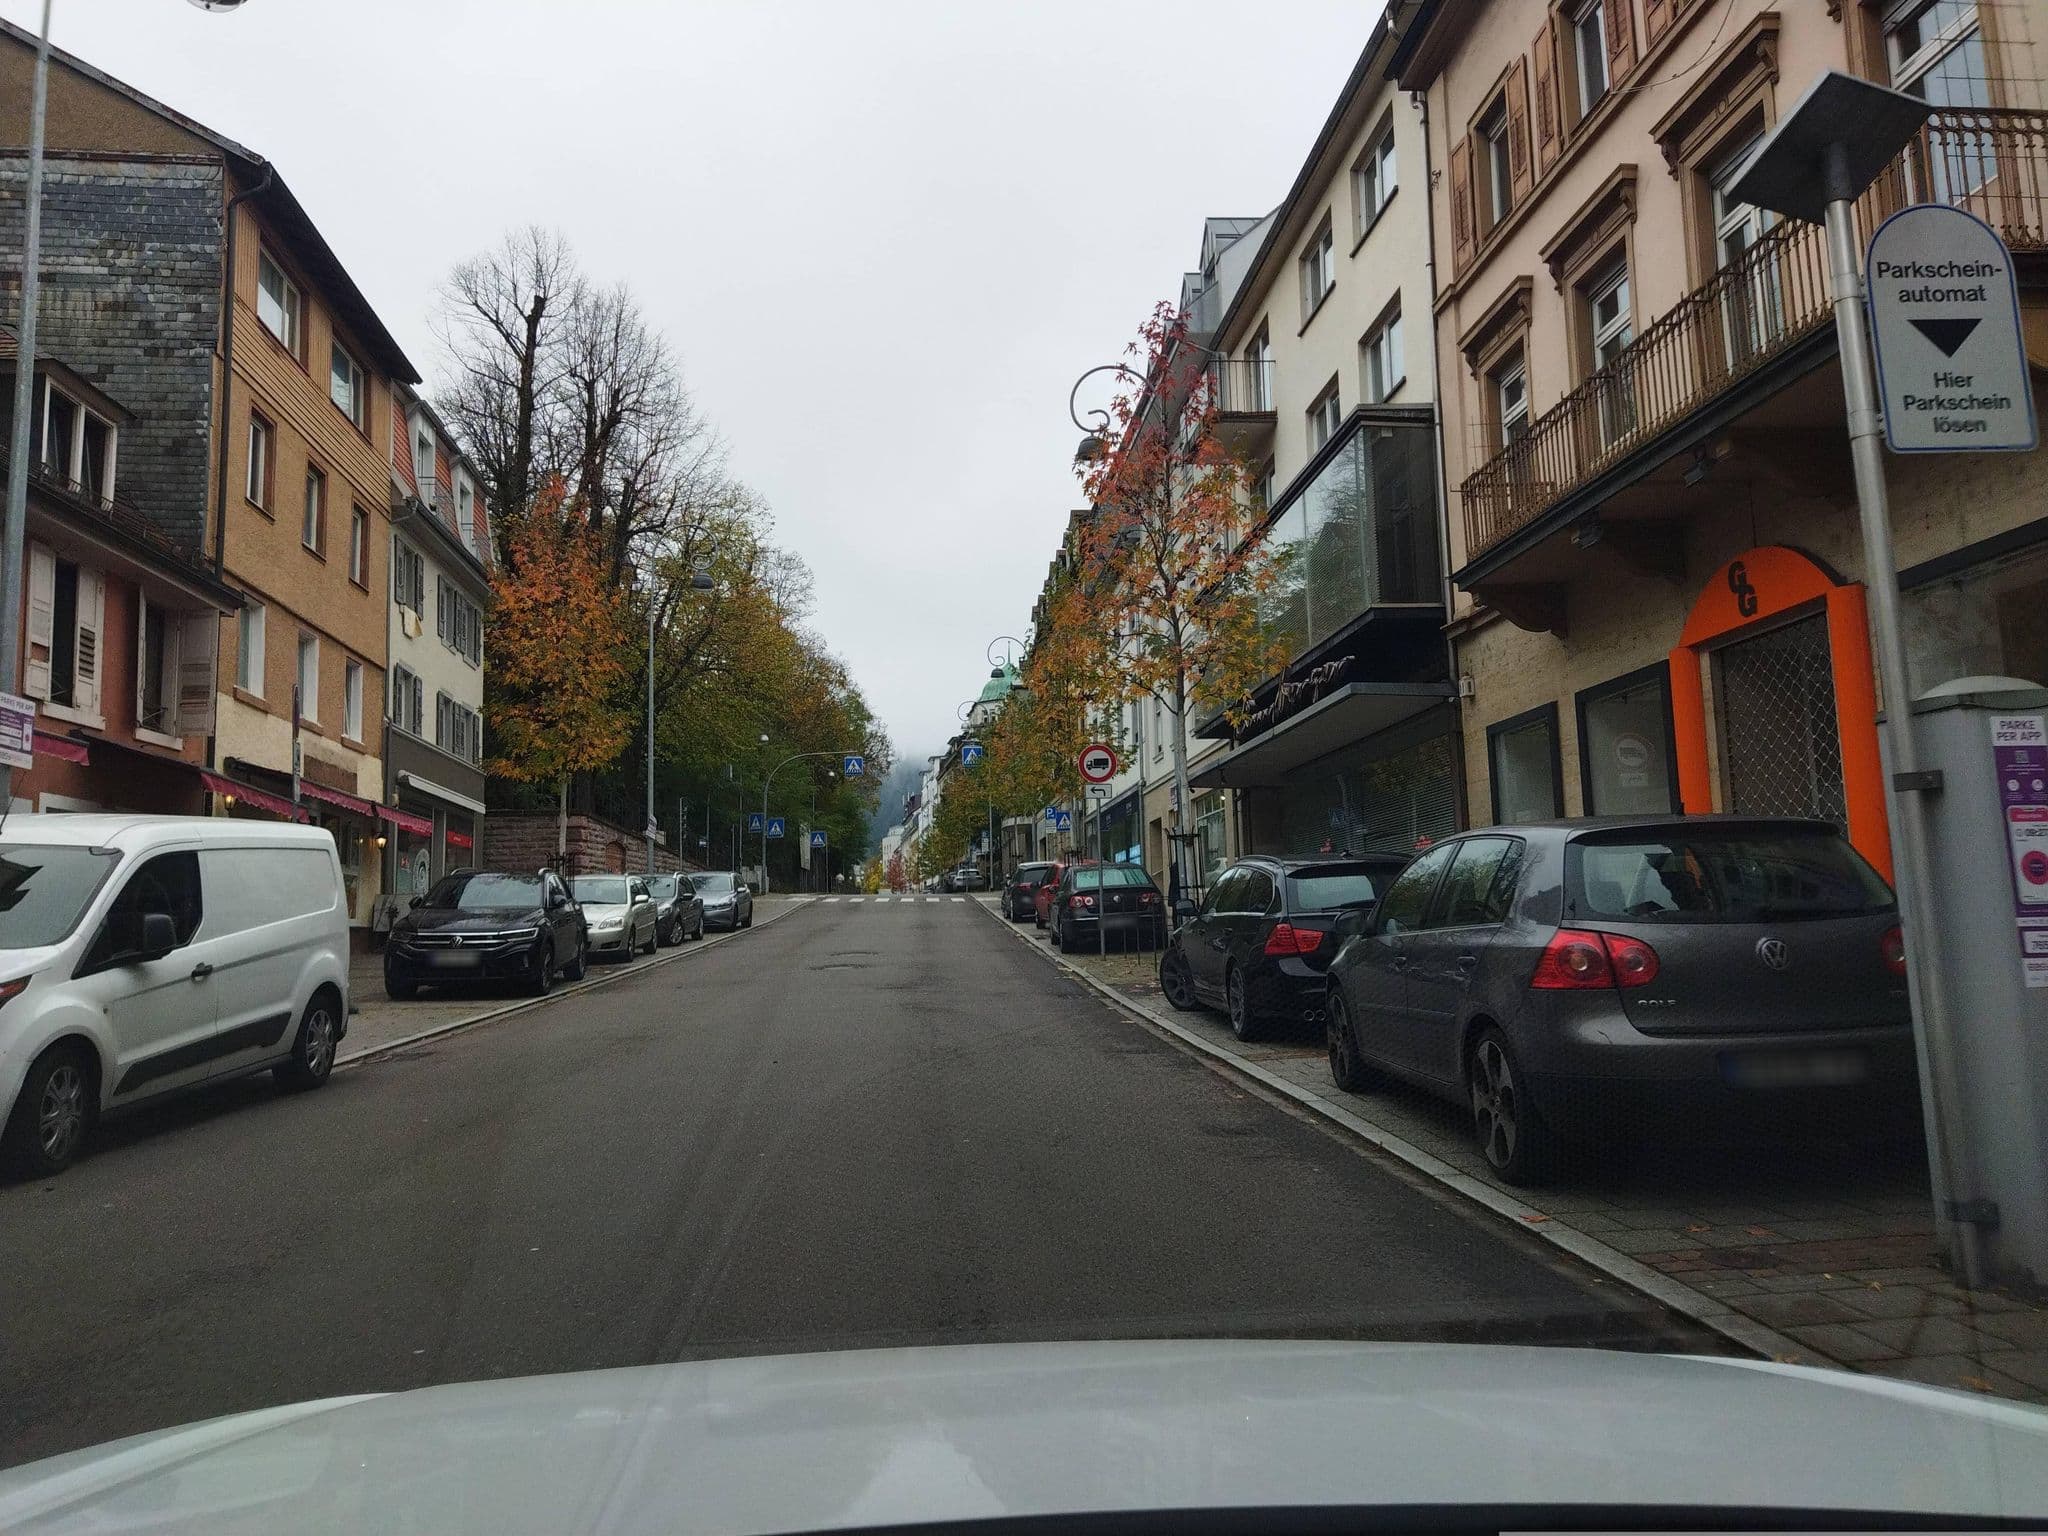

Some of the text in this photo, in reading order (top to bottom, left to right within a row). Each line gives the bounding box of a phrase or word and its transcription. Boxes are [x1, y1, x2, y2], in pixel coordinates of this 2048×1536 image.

[1877, 260, 2002, 278] Parkschein-
[1898, 284, 1987, 303] automat
[1933, 371, 1974, 388] Hier
[1903, 393, 2011, 411] Parkschein
[1933, 416, 1986, 433] lösen
[1999, 720, 2035, 730] PARKE
[1996, 731, 2042, 741] PER APP
